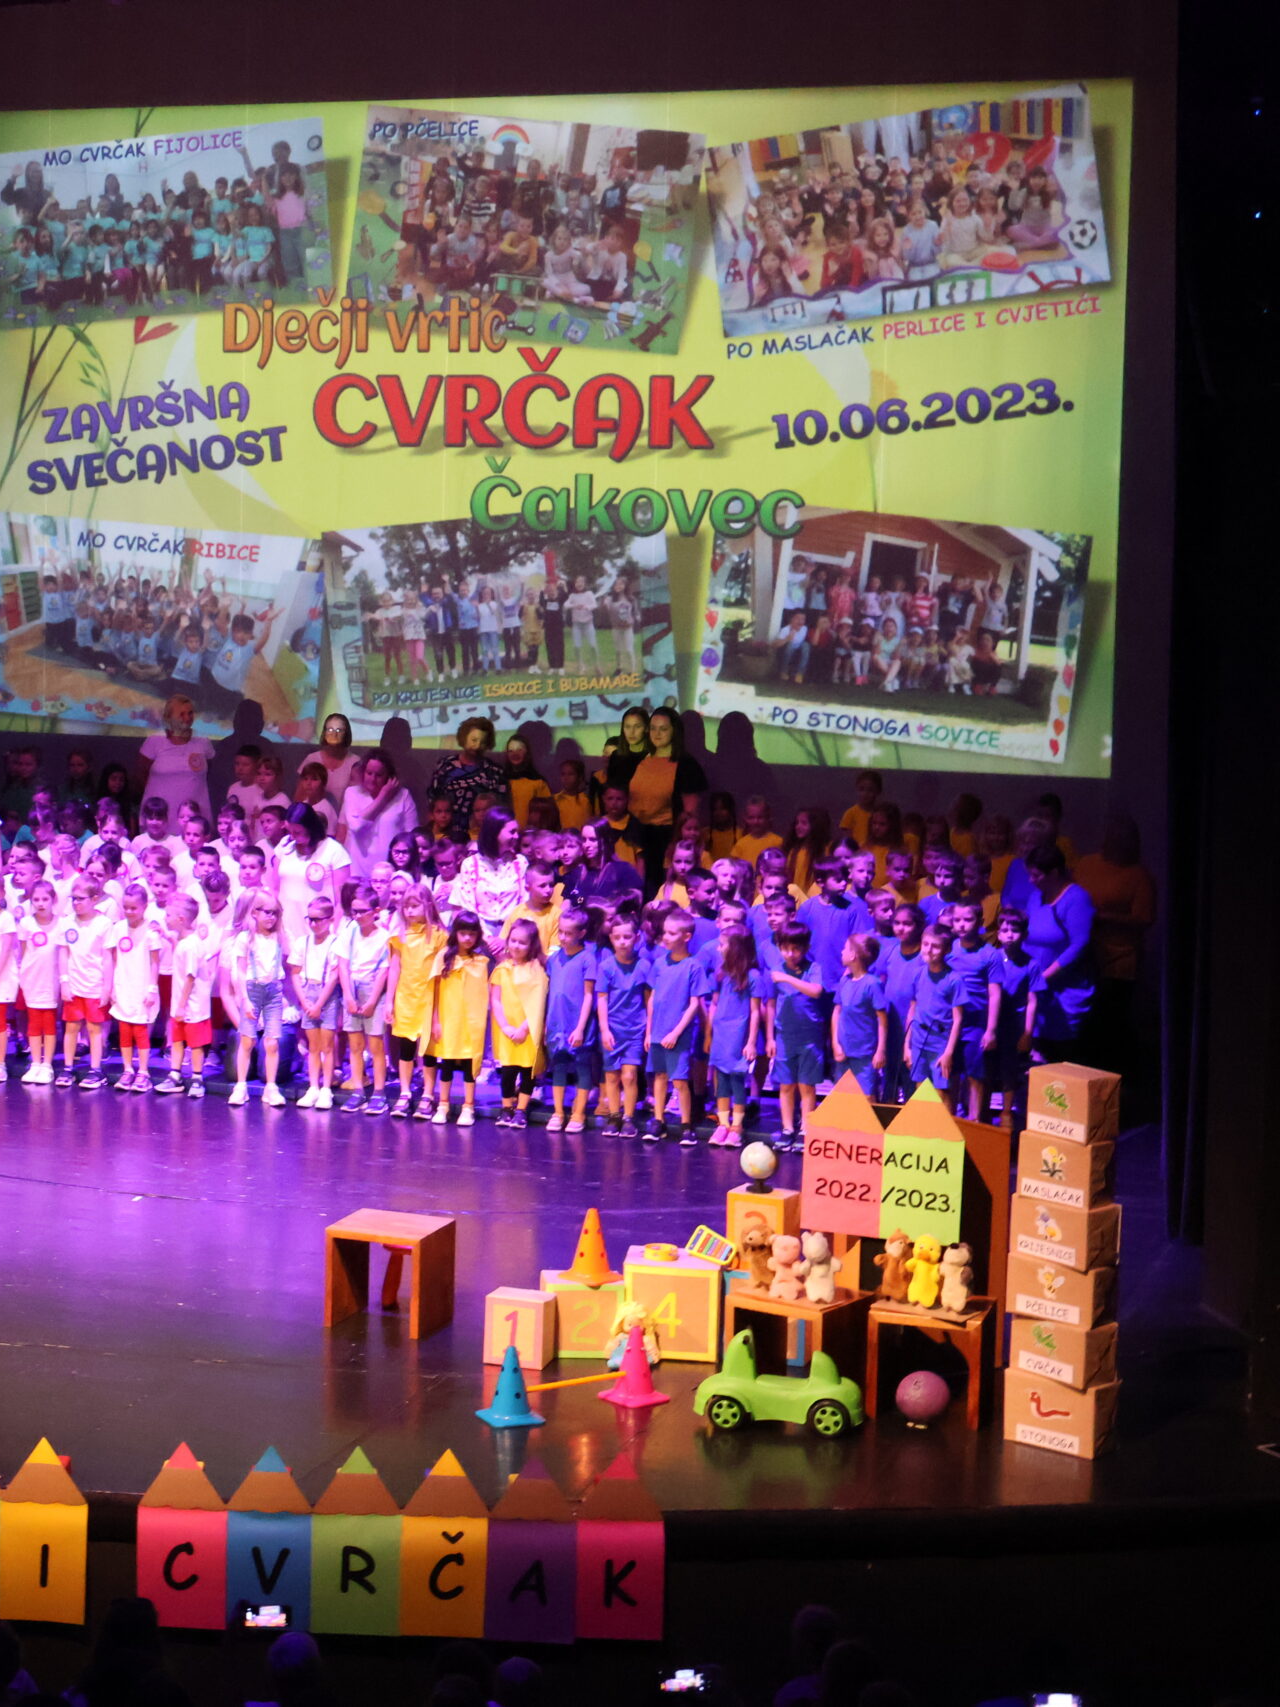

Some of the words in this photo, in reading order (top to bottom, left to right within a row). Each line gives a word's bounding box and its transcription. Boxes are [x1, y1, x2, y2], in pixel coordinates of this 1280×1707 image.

[44, 150, 72, 167] MO
[80, 140, 146, 164] CVRČAK
[154, 130, 243, 156] FIJOLICE
[369, 121, 397, 140] PO
[401, 118, 479, 139] PČELICE
[222, 286, 370, 369] Dječji
[384, 291, 509, 354] vrtić
[726, 342, 753, 359] PO
[762, 325, 875, 355] MASLAČAK
[883, 313, 965, 339] PERLICE
[975, 311, 986, 328] I
[996, 293, 1103, 326] CVJETIĆI
[42, 378, 251, 445] ZAVRŠNA
[312, 345, 715, 462] CVRČAK
[771, 378, 1075, 450] 10.06.2023.
[26, 425, 287, 496] SVEČANOST
[470, 455, 806, 540] Čakovec
[77, 531, 106, 548] MO
[113, 533, 185, 556] CVRČAK
[192, 540, 262, 563] RIBICE
[372, 692, 391, 706] PO
[483, 678, 543, 697] ISKRICE
[546, 678, 555, 693] I
[559, 673, 642, 693] BUBAMARE
[771, 706, 798, 724] PO
[807, 712, 911, 737] STONOGA
[920, 723, 1001, 749] SOVICE
[1037, 1118, 1075, 1137] CVRČAK
[808, 1138, 950, 1174] GENERACIJA
[1023, 1182, 1082, 1204] MASLAČAK
[571, 1301, 602, 1344] 2
[648, 1291, 683, 1339] 4
[1024, 1299, 1071, 1319] PČELICE
[503, 1310, 521, 1353] 1
[1021, 1429, 1075, 1450] STONOGA
[162, 1530, 638, 1608] CVRČAK
